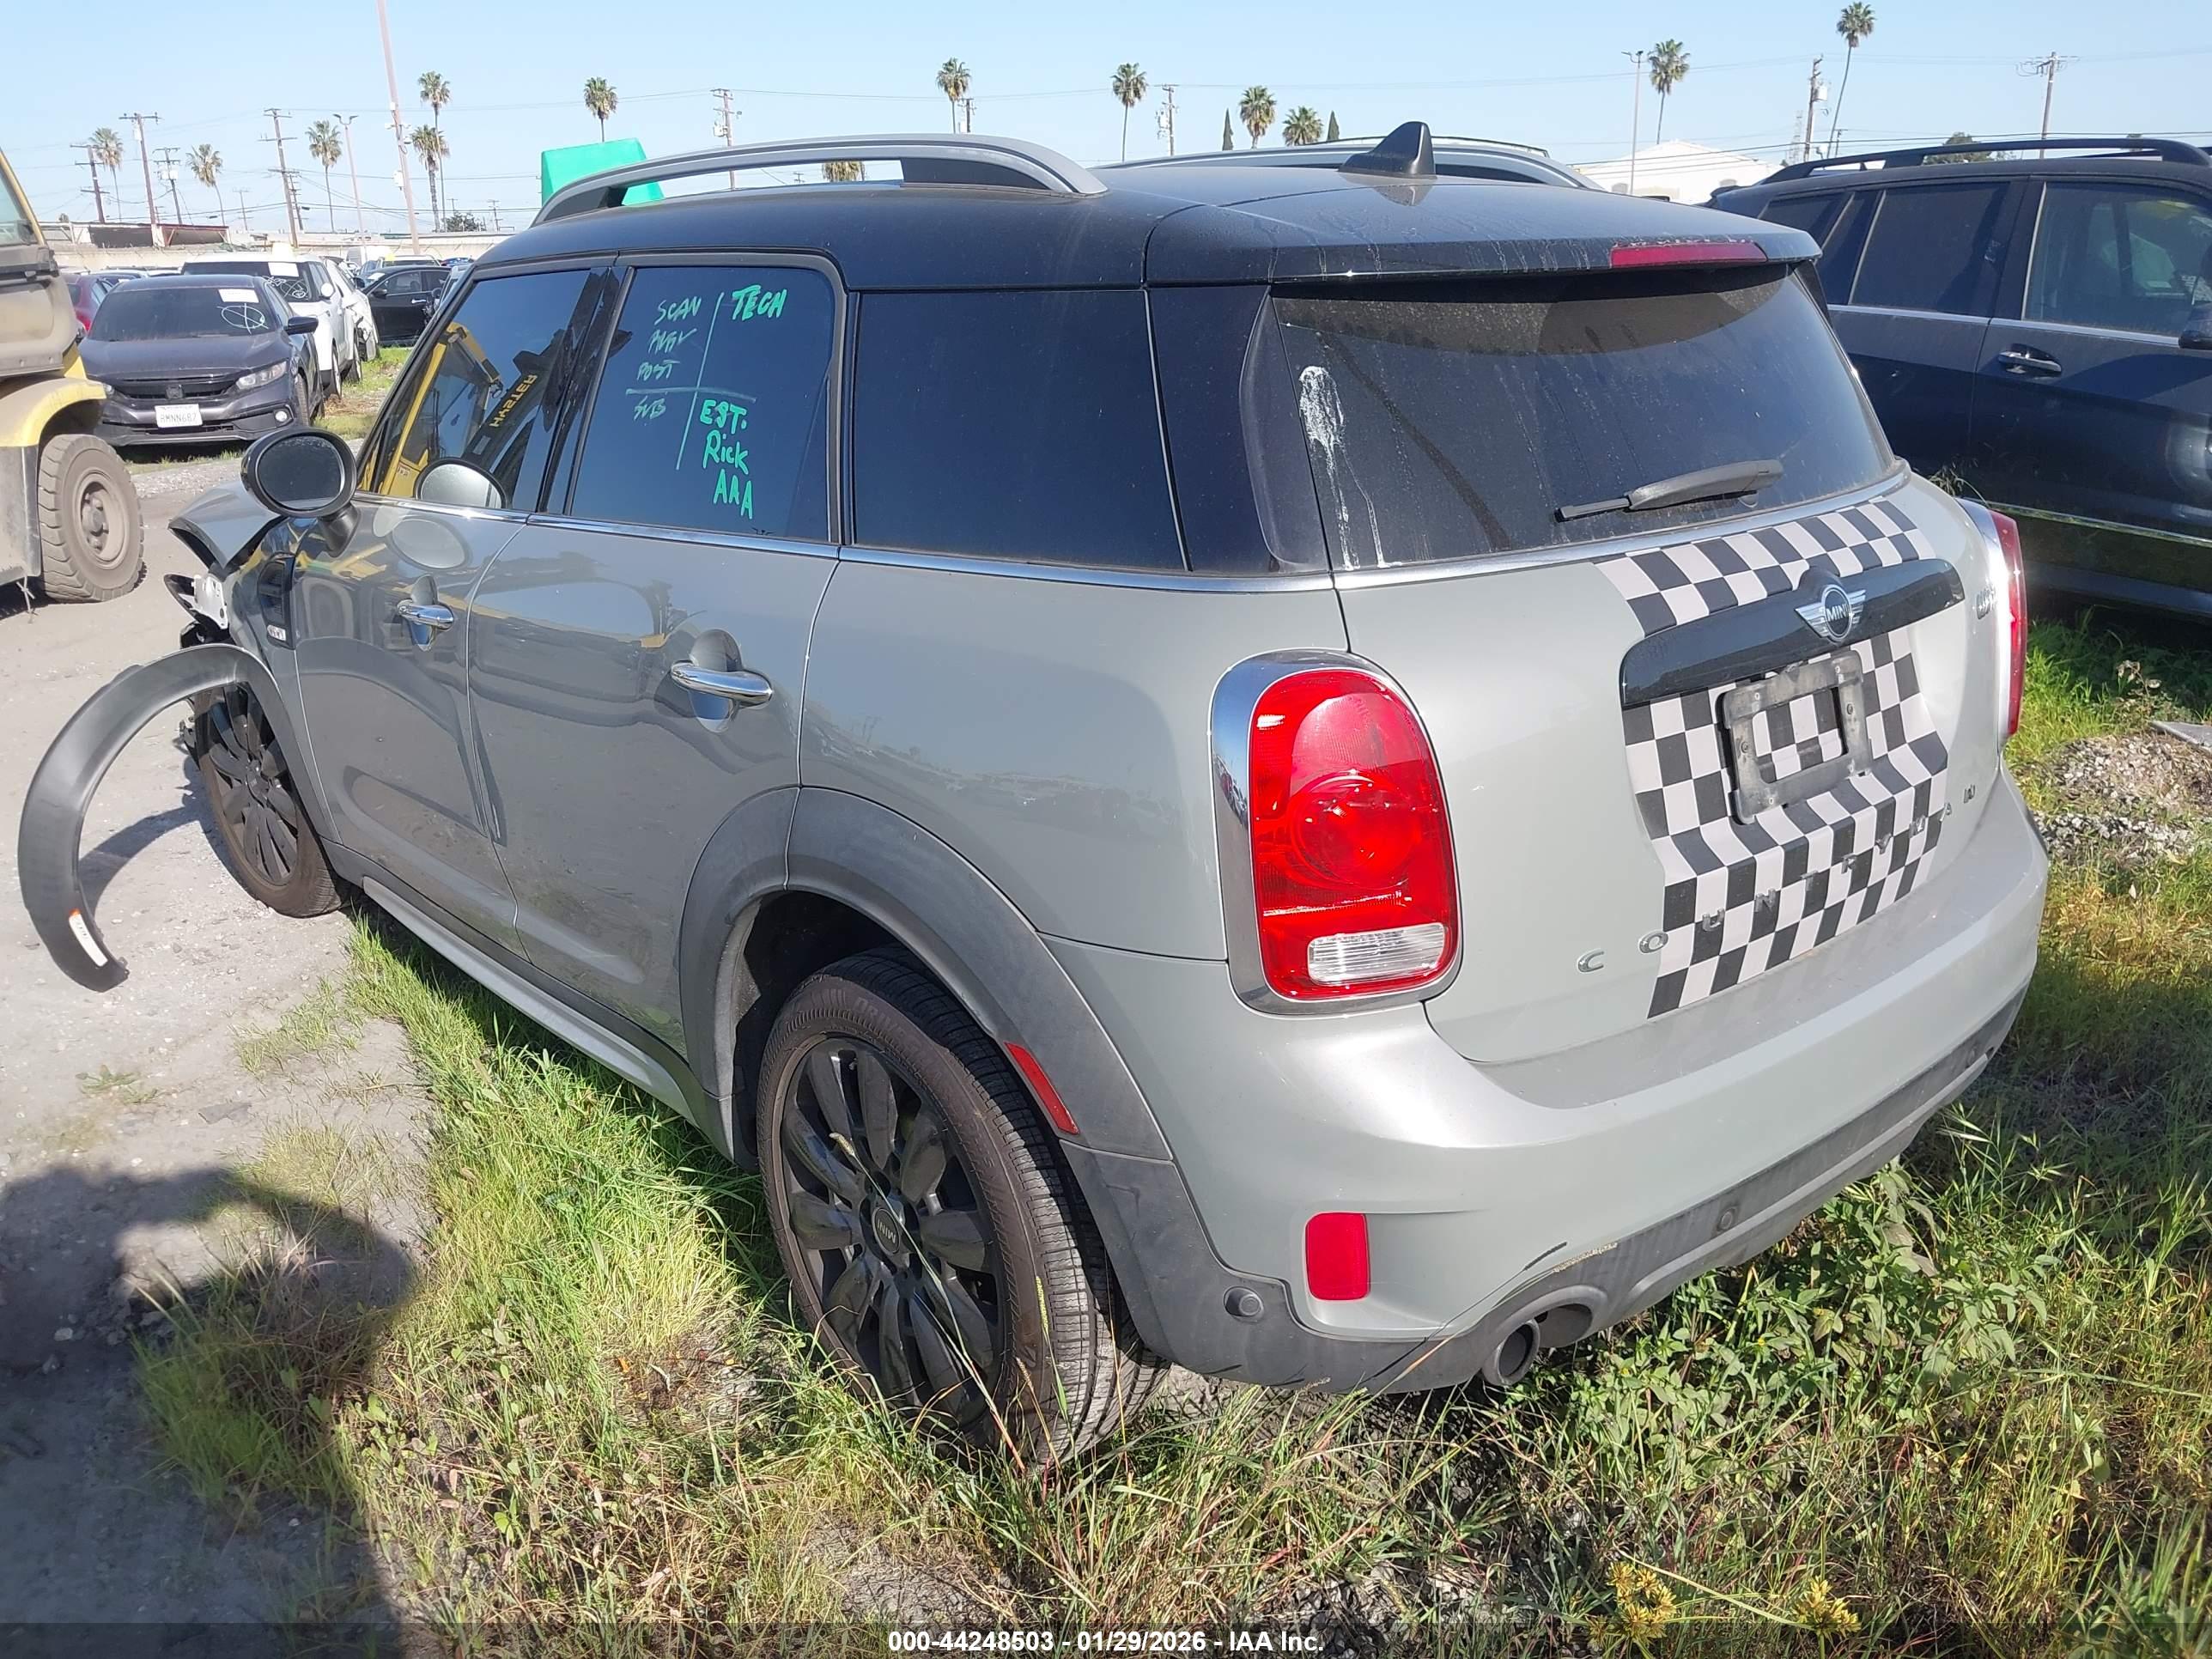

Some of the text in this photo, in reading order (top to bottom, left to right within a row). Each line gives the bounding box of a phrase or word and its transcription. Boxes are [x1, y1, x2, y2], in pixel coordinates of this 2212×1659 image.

[654, 296, 702, 325] SCAN
[732, 284, 787, 320] TECH
[699, 399, 747, 434] EST.
[702, 429, 749, 475] Rick
[714, 468, 753, 520] AAA
[1826, 603, 1850, 623] MINI
[877, 1218, 896, 1244] MINI
